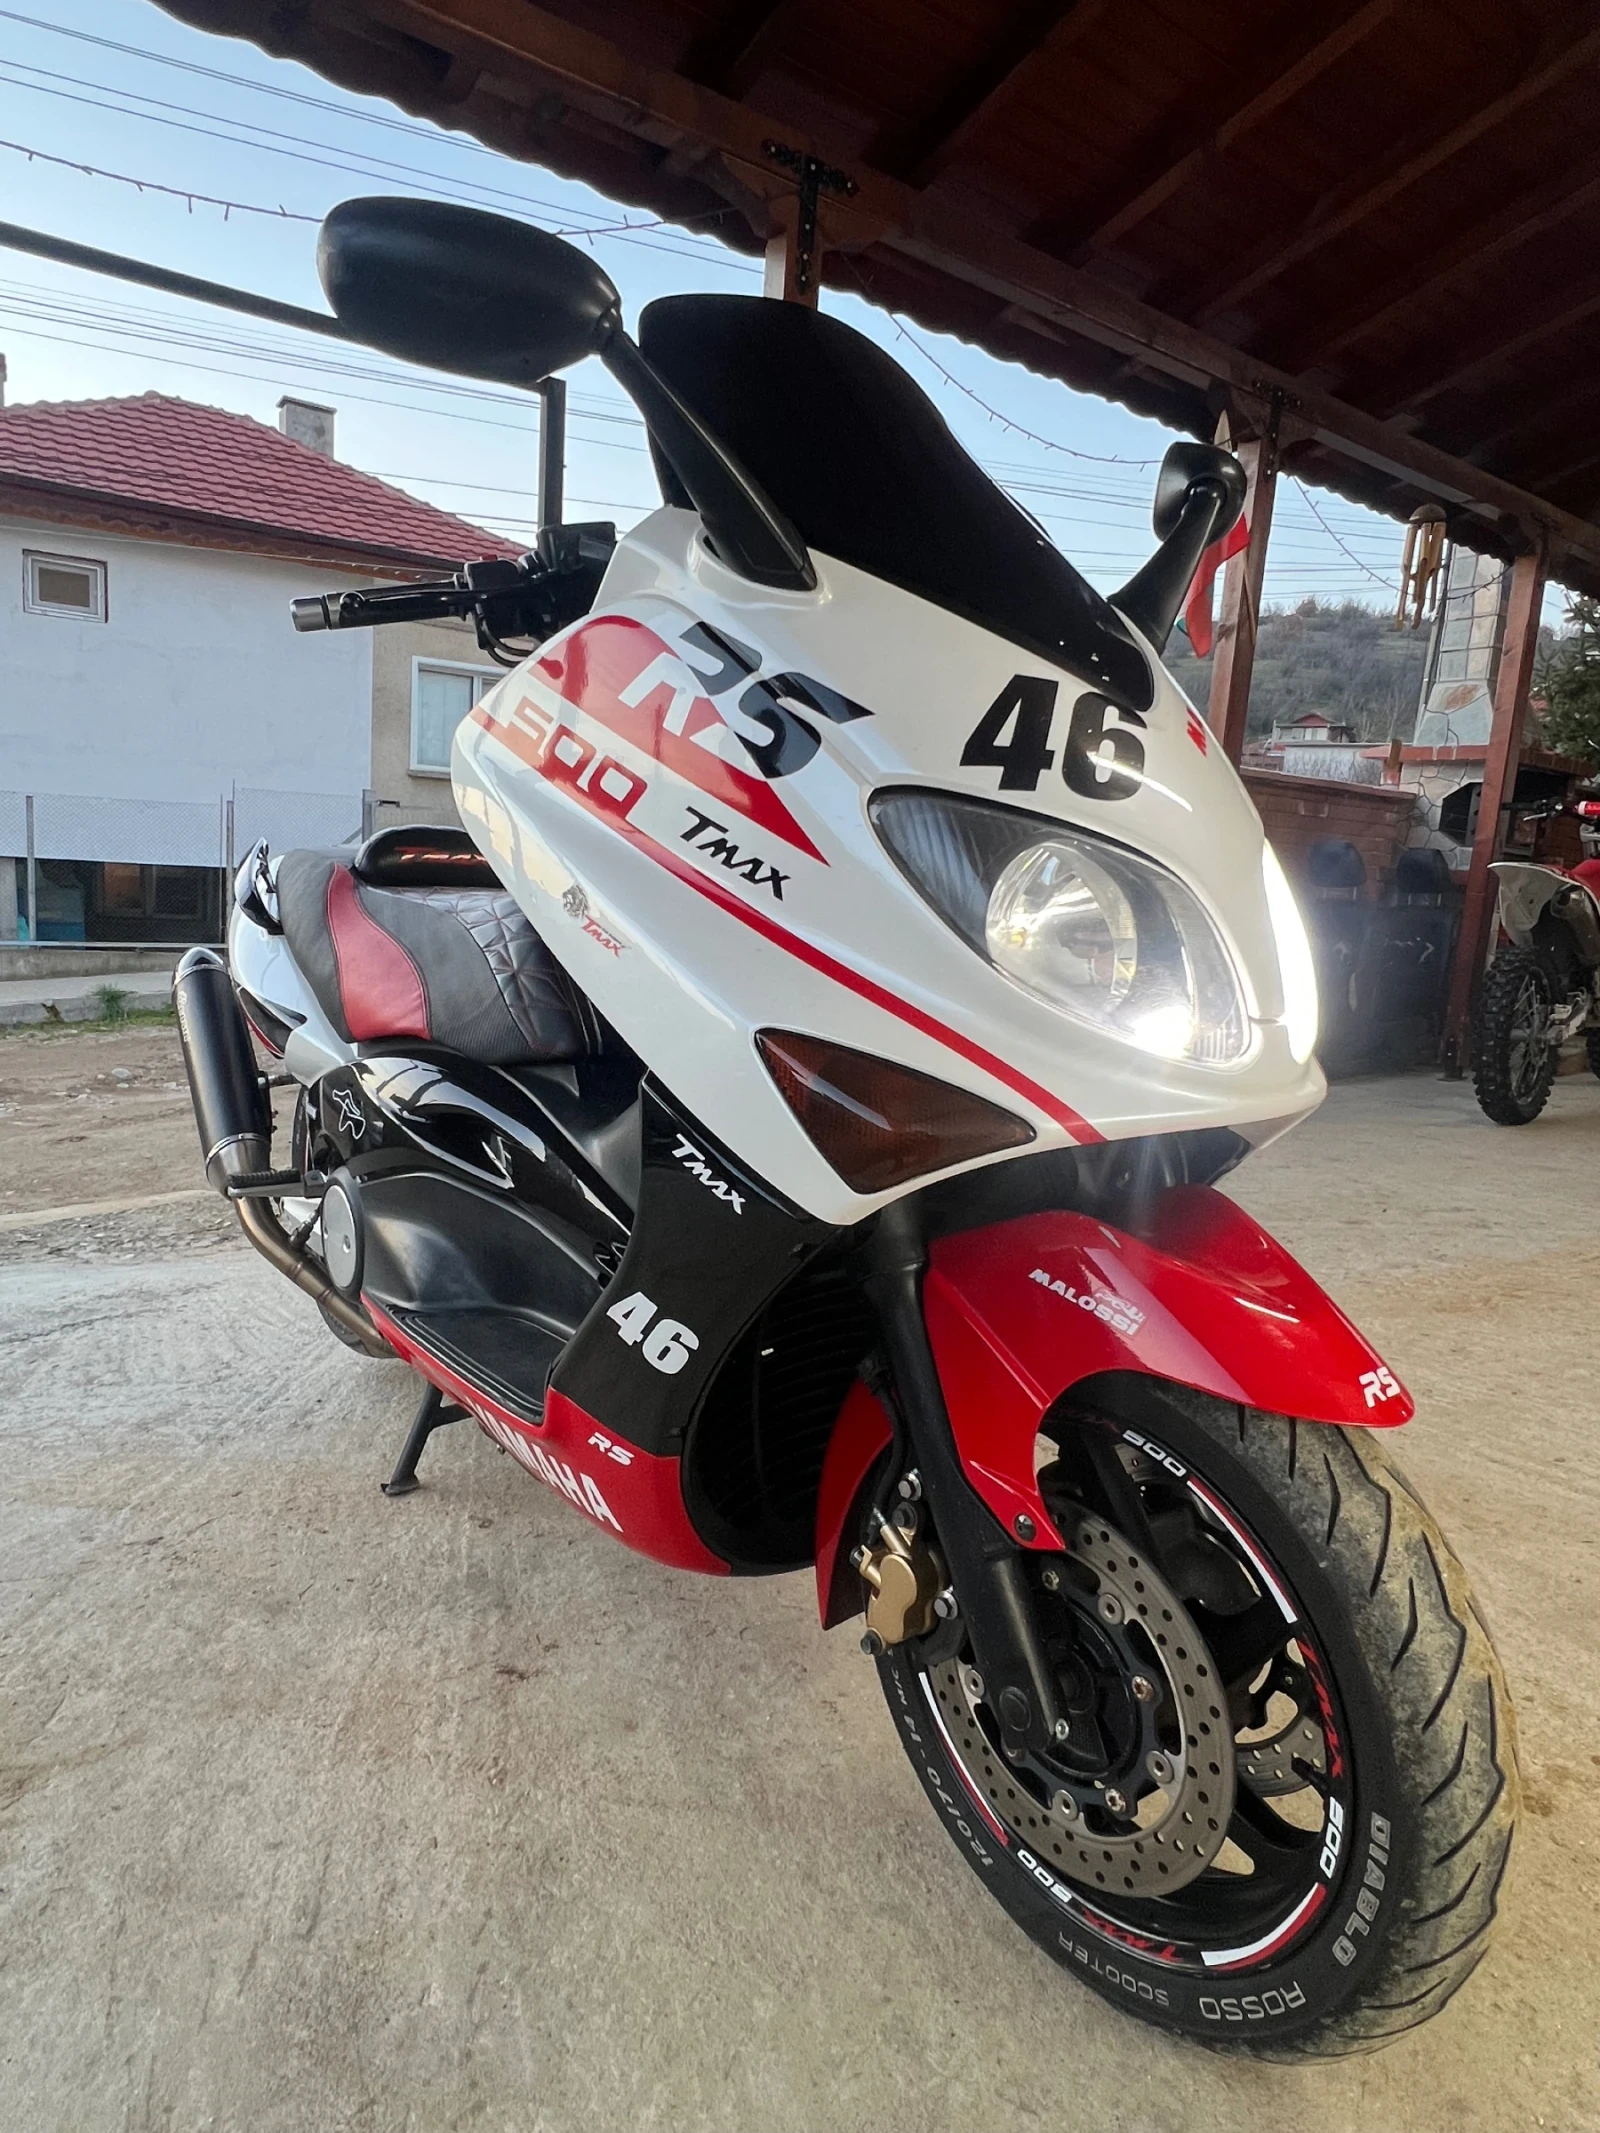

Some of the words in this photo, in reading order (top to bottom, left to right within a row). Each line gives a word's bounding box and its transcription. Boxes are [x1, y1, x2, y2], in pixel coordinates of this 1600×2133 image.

[618, 621, 876, 778] RS
[959, 674, 1147, 801] 46
[505, 695, 648, 820] 500
[679, 806, 790, 901] TMAX
[672, 1134, 746, 1214] TMAX
[606, 1291, 699, 1374] 46
[1028, 1268, 1139, 1335] MALOSSI
[1359, 1366, 1400, 1408] RS
[464, 1396, 624, 1533] YAMAHA
[587, 1432, 635, 1466] RS
[1122, 1429, 1187, 1478] 500
[1017, 1849, 1072, 1902] 500
[1320, 1796, 1343, 1879] 500
[1332, 1812, 1391, 1966] DIABLO
[1058, 1931, 1169, 2007] SCOOTER
[1199, 1981, 1306, 2020] ROSSO
